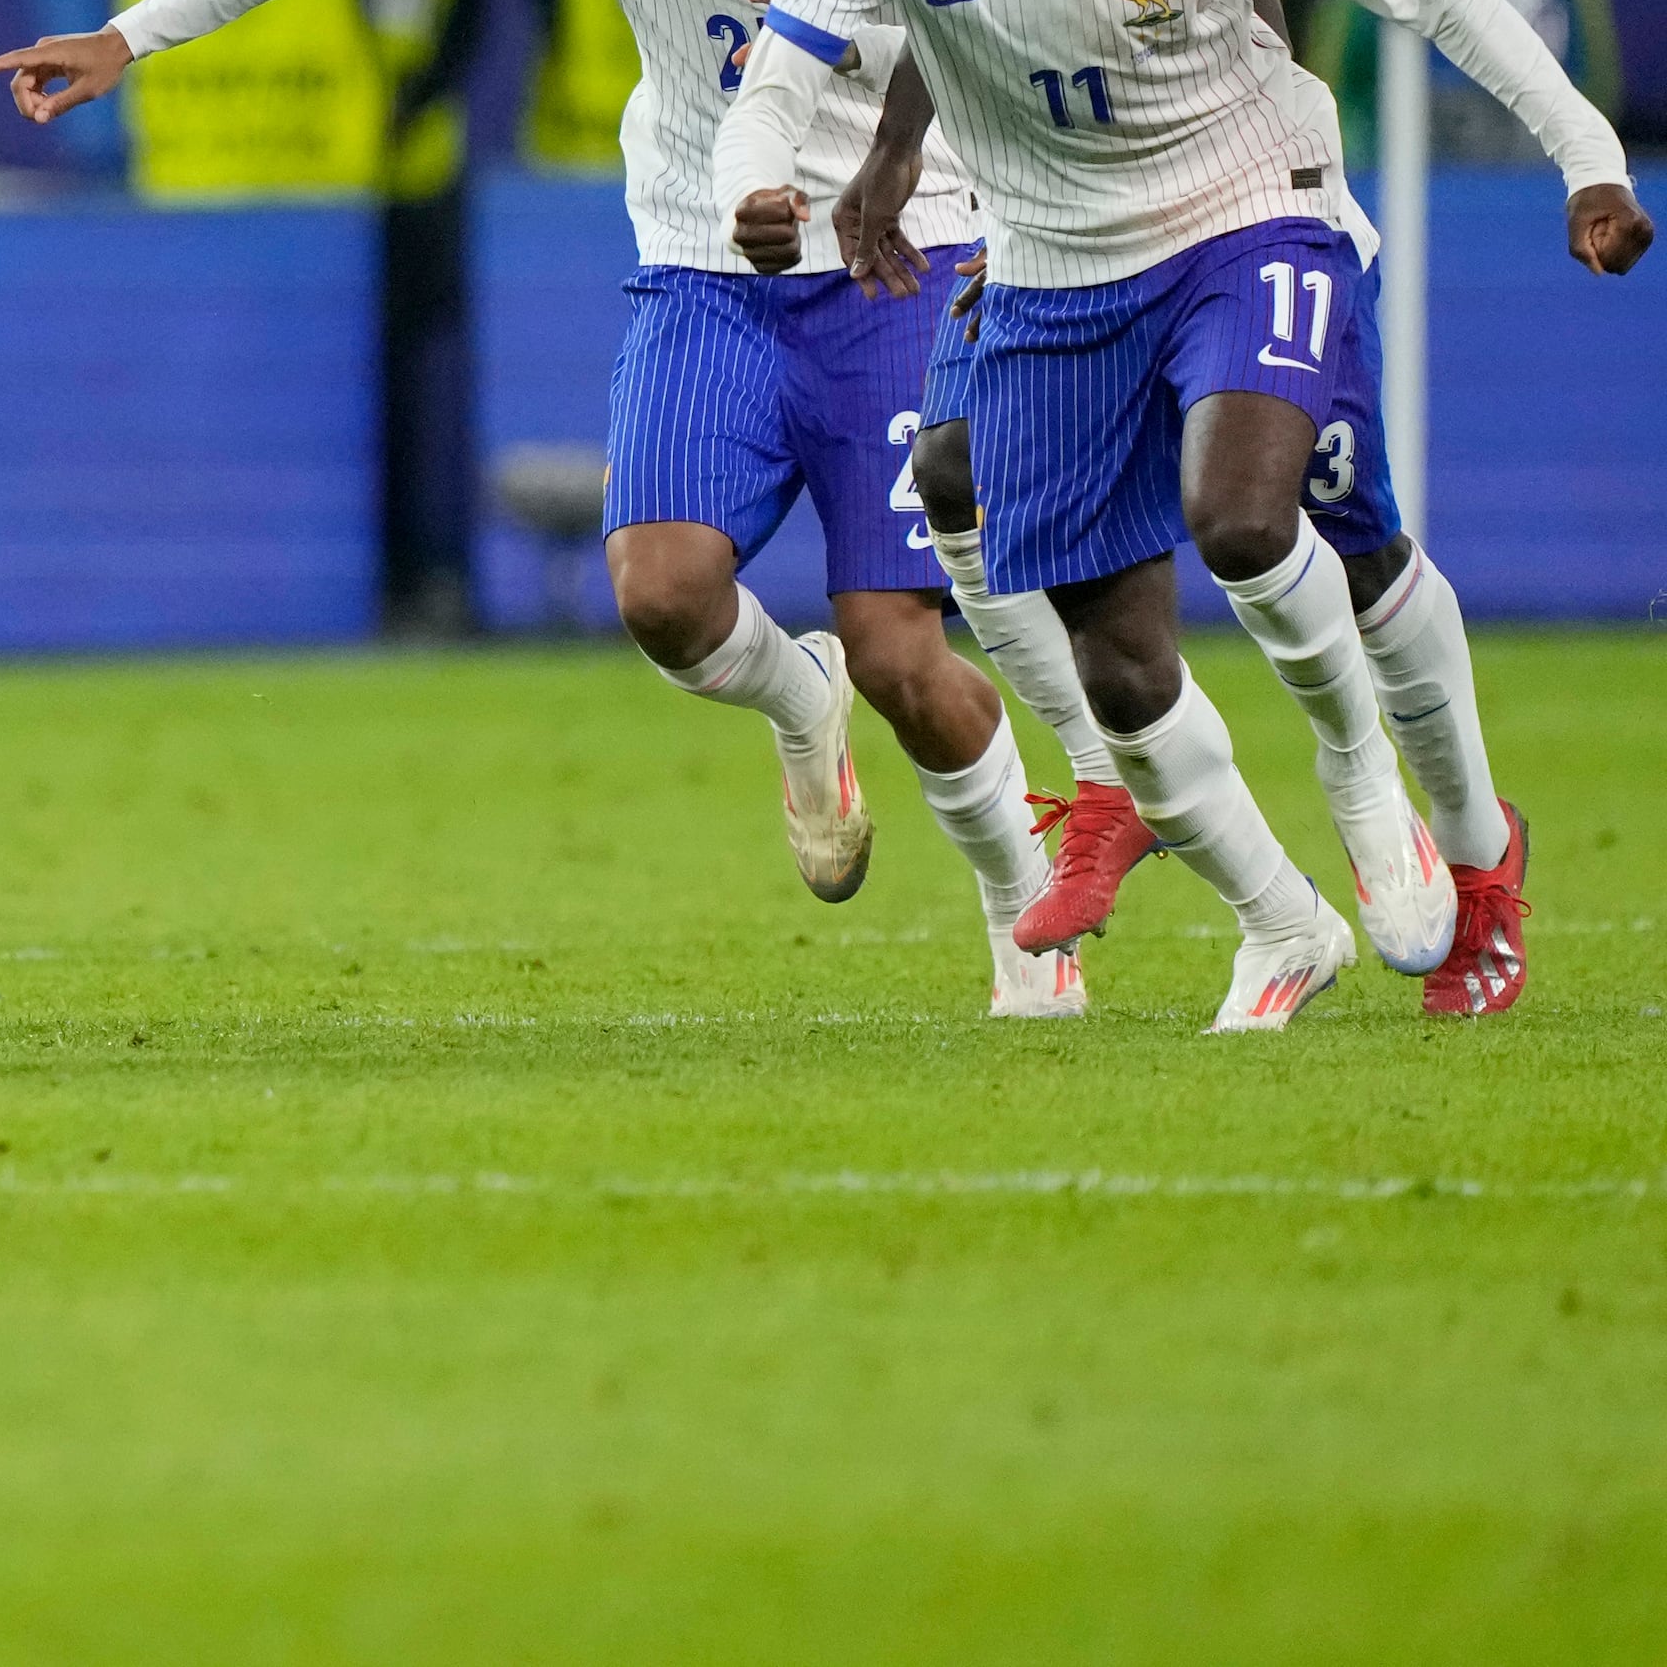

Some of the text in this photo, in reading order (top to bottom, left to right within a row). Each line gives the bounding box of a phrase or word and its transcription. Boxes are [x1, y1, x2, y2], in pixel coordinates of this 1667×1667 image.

[706, 13, 765, 93] 2
[1029, 66, 1116, 130] 11
[1259, 260, 1333, 363] 11
